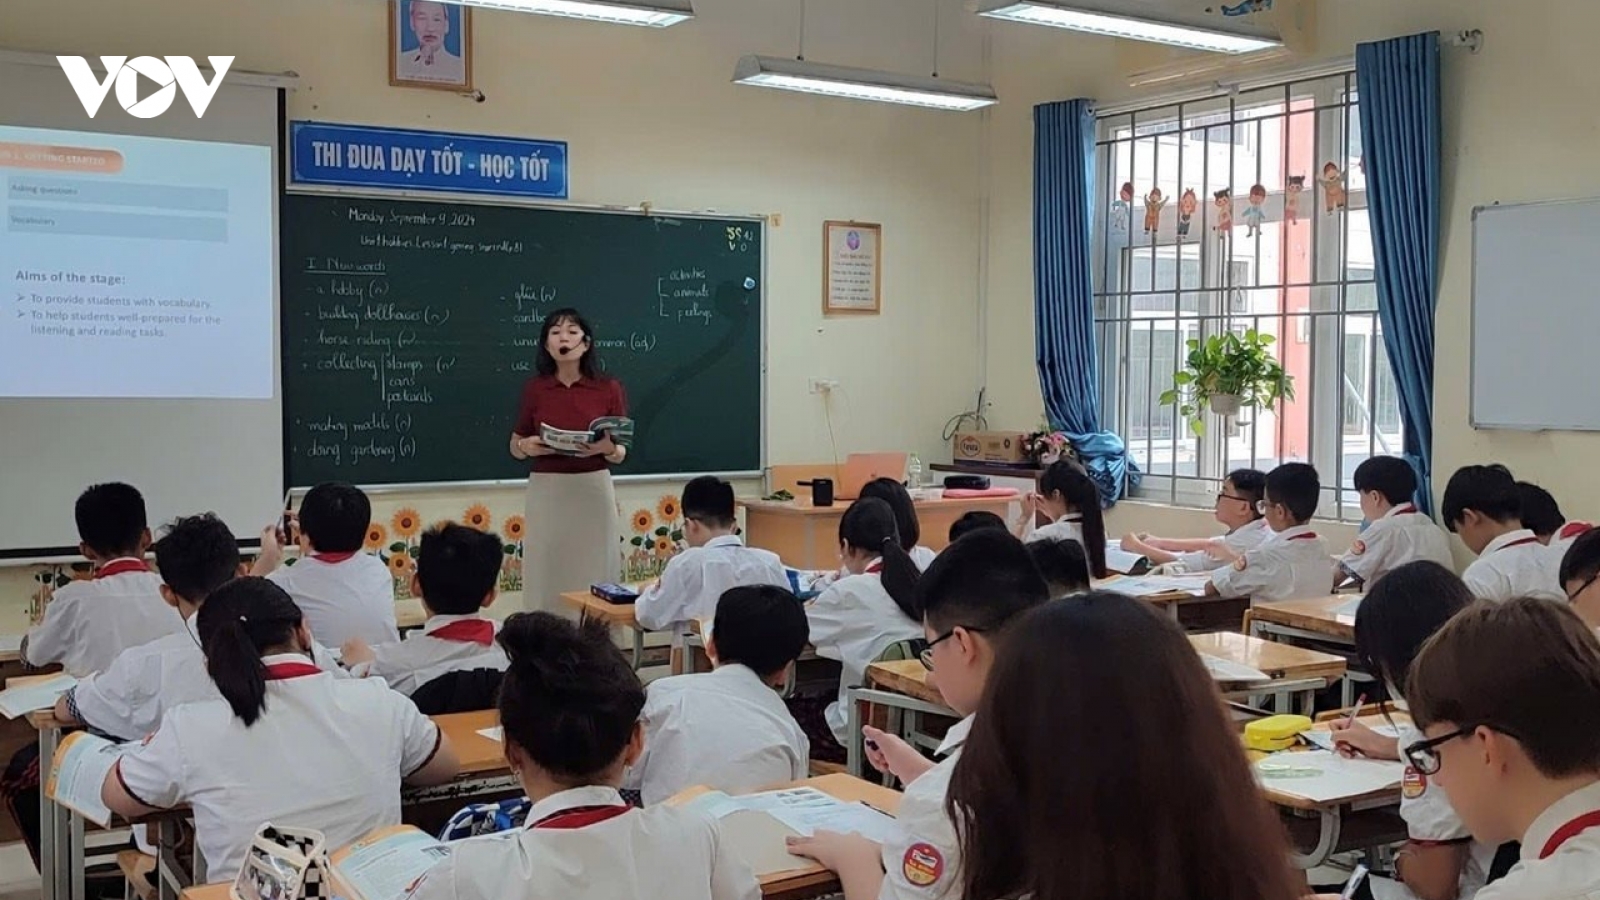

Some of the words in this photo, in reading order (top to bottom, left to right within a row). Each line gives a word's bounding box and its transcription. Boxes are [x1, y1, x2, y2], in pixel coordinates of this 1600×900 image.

[312, 141, 342, 168] THI
[347, 144, 386, 171] ĐUA
[390, 146, 426, 178] DẠY
[431, 142, 463, 176] TỐT
[480, 154, 515, 183] HỌC
[519, 149, 550, 181] TỐT
[16, 270, 47, 281] Aims
[50, 271, 63, 283] of
[65, 272, 86, 283] the
[89, 274, 126, 287] stage:
[31, 293, 42, 303] To
[45, 294, 86, 306] provide
[87, 295, 131, 307] students
[134, 297, 156, 307] with
[330, 278, 365, 307] hobby
[31, 310, 42, 320] To
[45, 310, 69, 321] help
[71, 311, 115, 321] students
[118, 312, 187, 325] well-prepared
[189, 314, 203, 325] for
[204, 315, 221, 326] the
[31, 325, 75, 337] listening
[77, 326, 97, 336] and
[99, 326, 137, 339] reading
[316, 353, 379, 382] collecting
